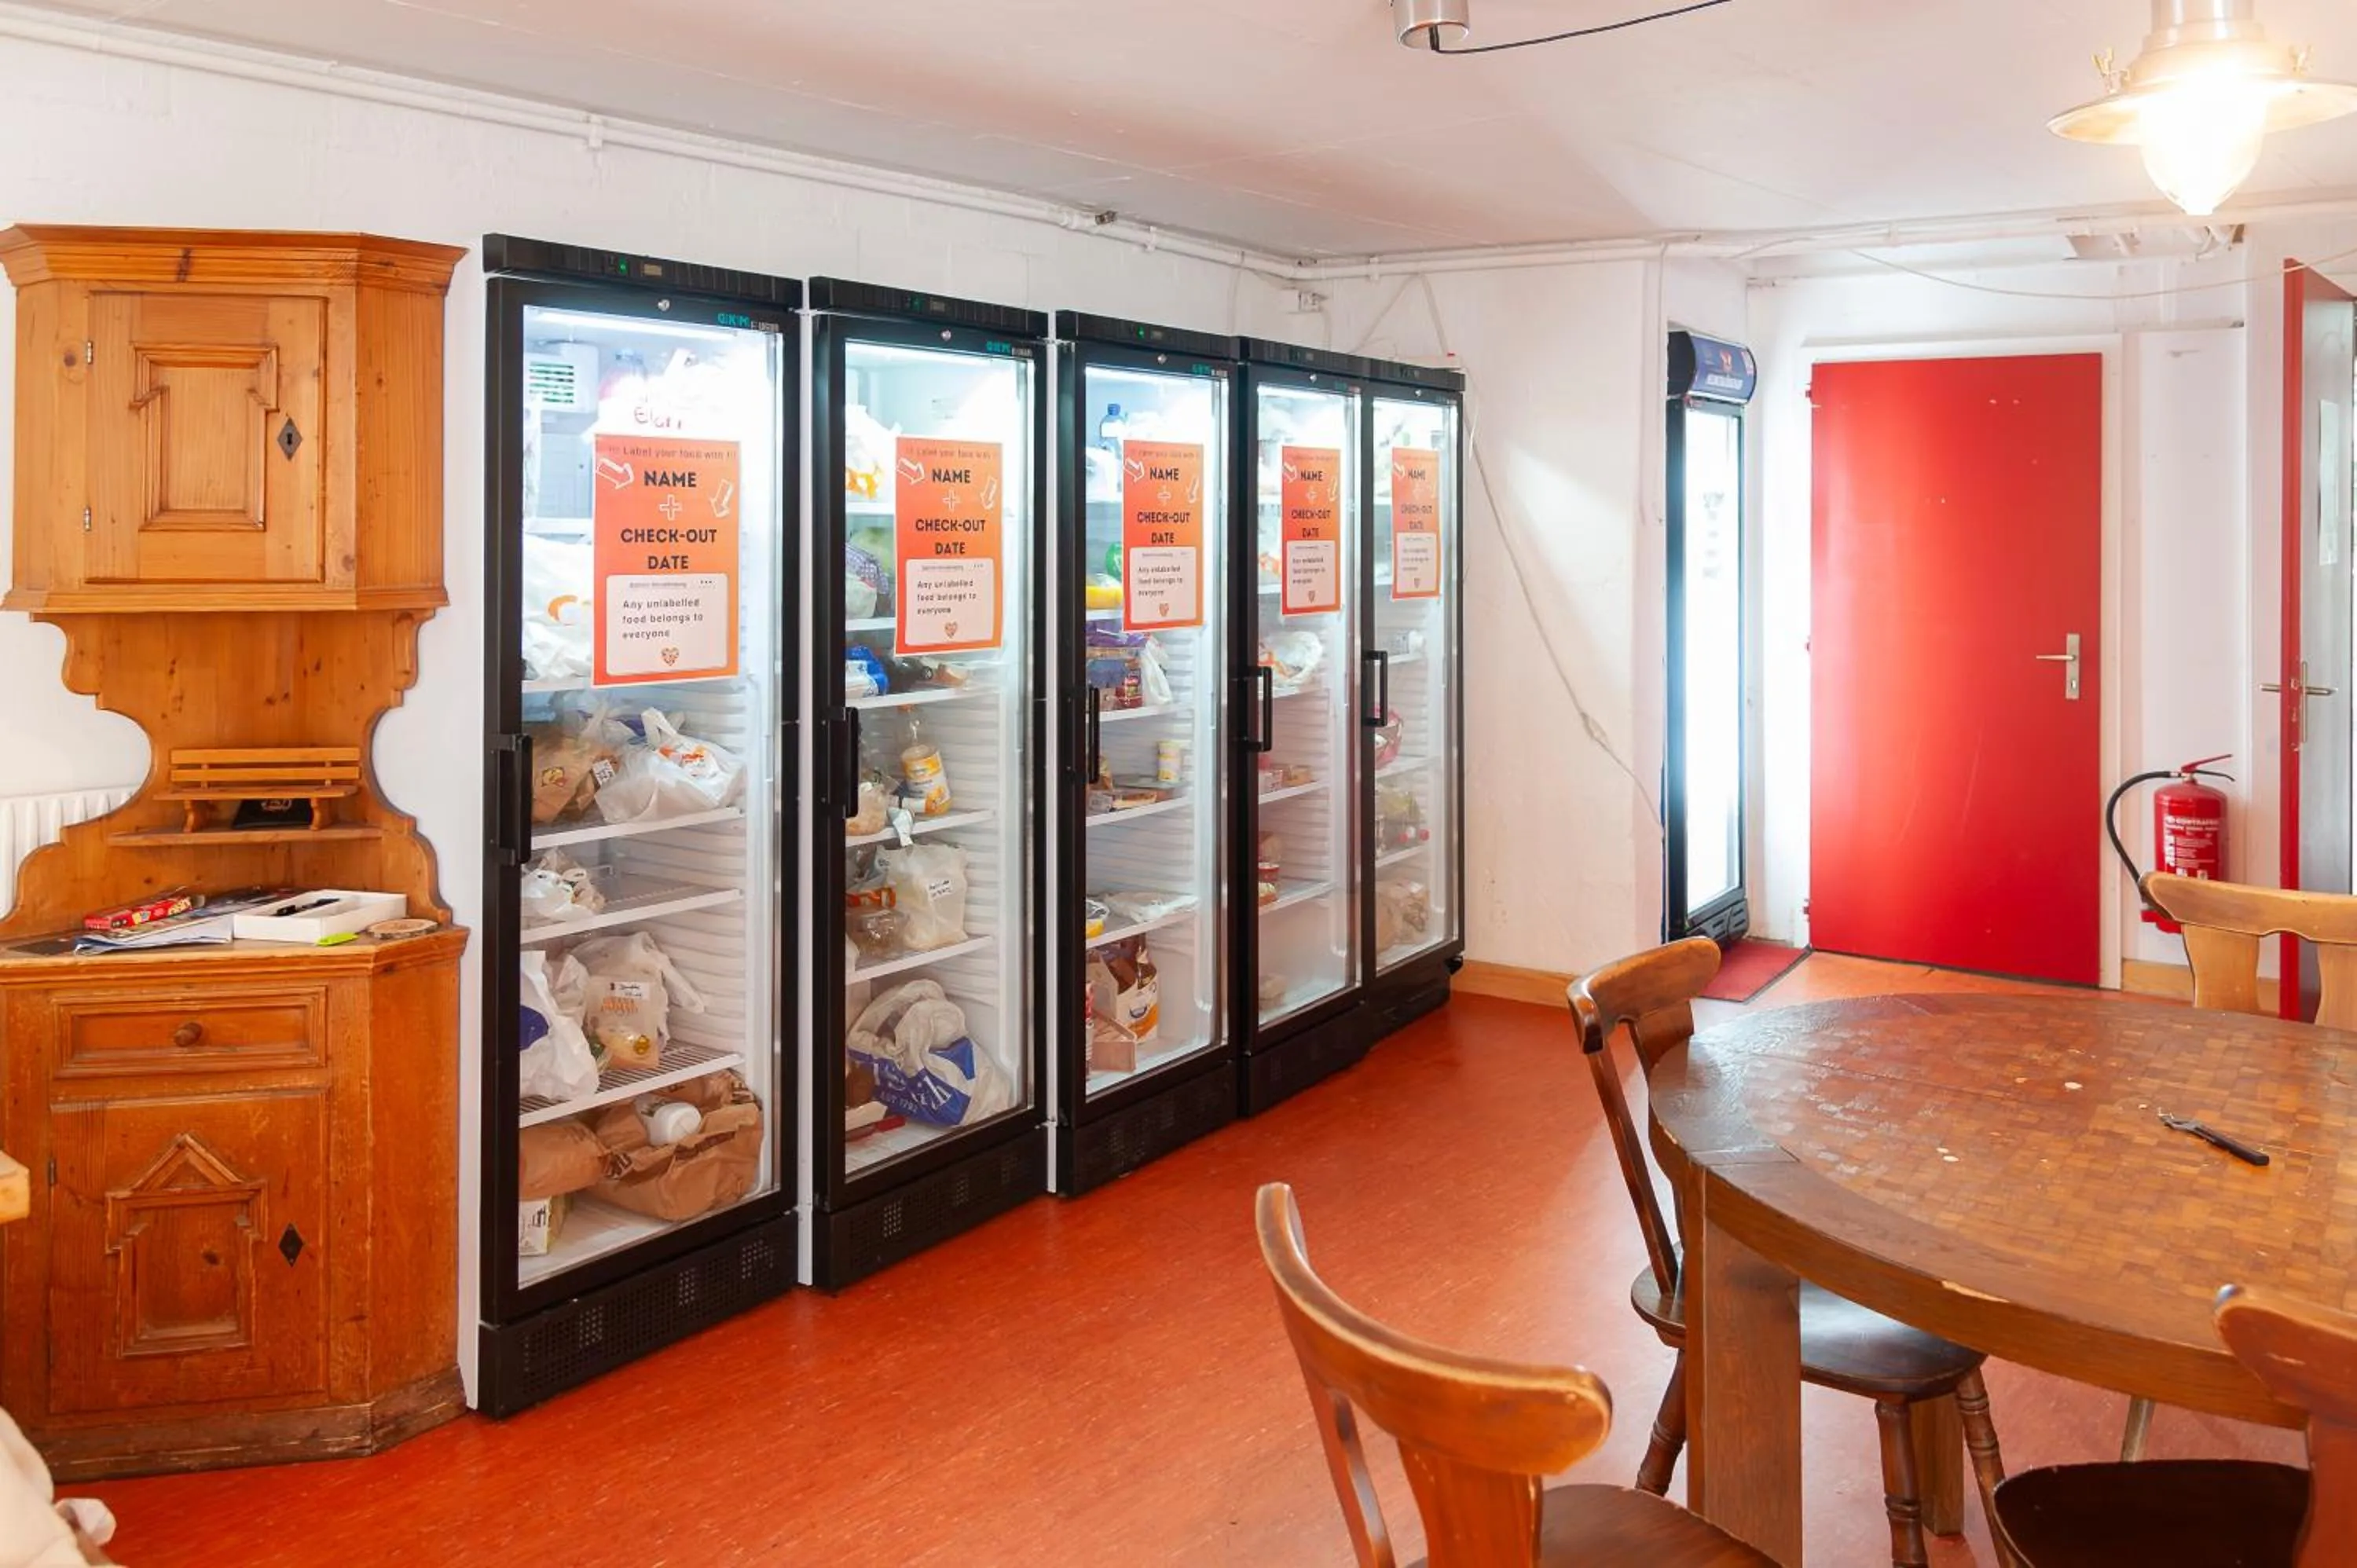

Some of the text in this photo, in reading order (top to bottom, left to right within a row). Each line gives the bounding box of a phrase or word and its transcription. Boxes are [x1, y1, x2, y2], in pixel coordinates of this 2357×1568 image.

[644, 471, 697, 488] NAME
[932, 469, 971, 484] NAME
[1149, 467, 1179, 481] NAME
[1300, 470, 1323, 482] NAME
[1137, 511, 1190, 523] CHECK-OUT
[915, 519, 986, 532] CHECK-OUT
[621, 528, 717, 544] CHECK-OUT
[1151, 533, 1175, 544] DATE
[935, 542, 966, 555] DATE
[647, 555, 689, 570] DATE
[623, 598, 701, 610] Any unlabelled
[622, 613, 703, 625] food belongs to
[622, 630, 670, 640] everyone
